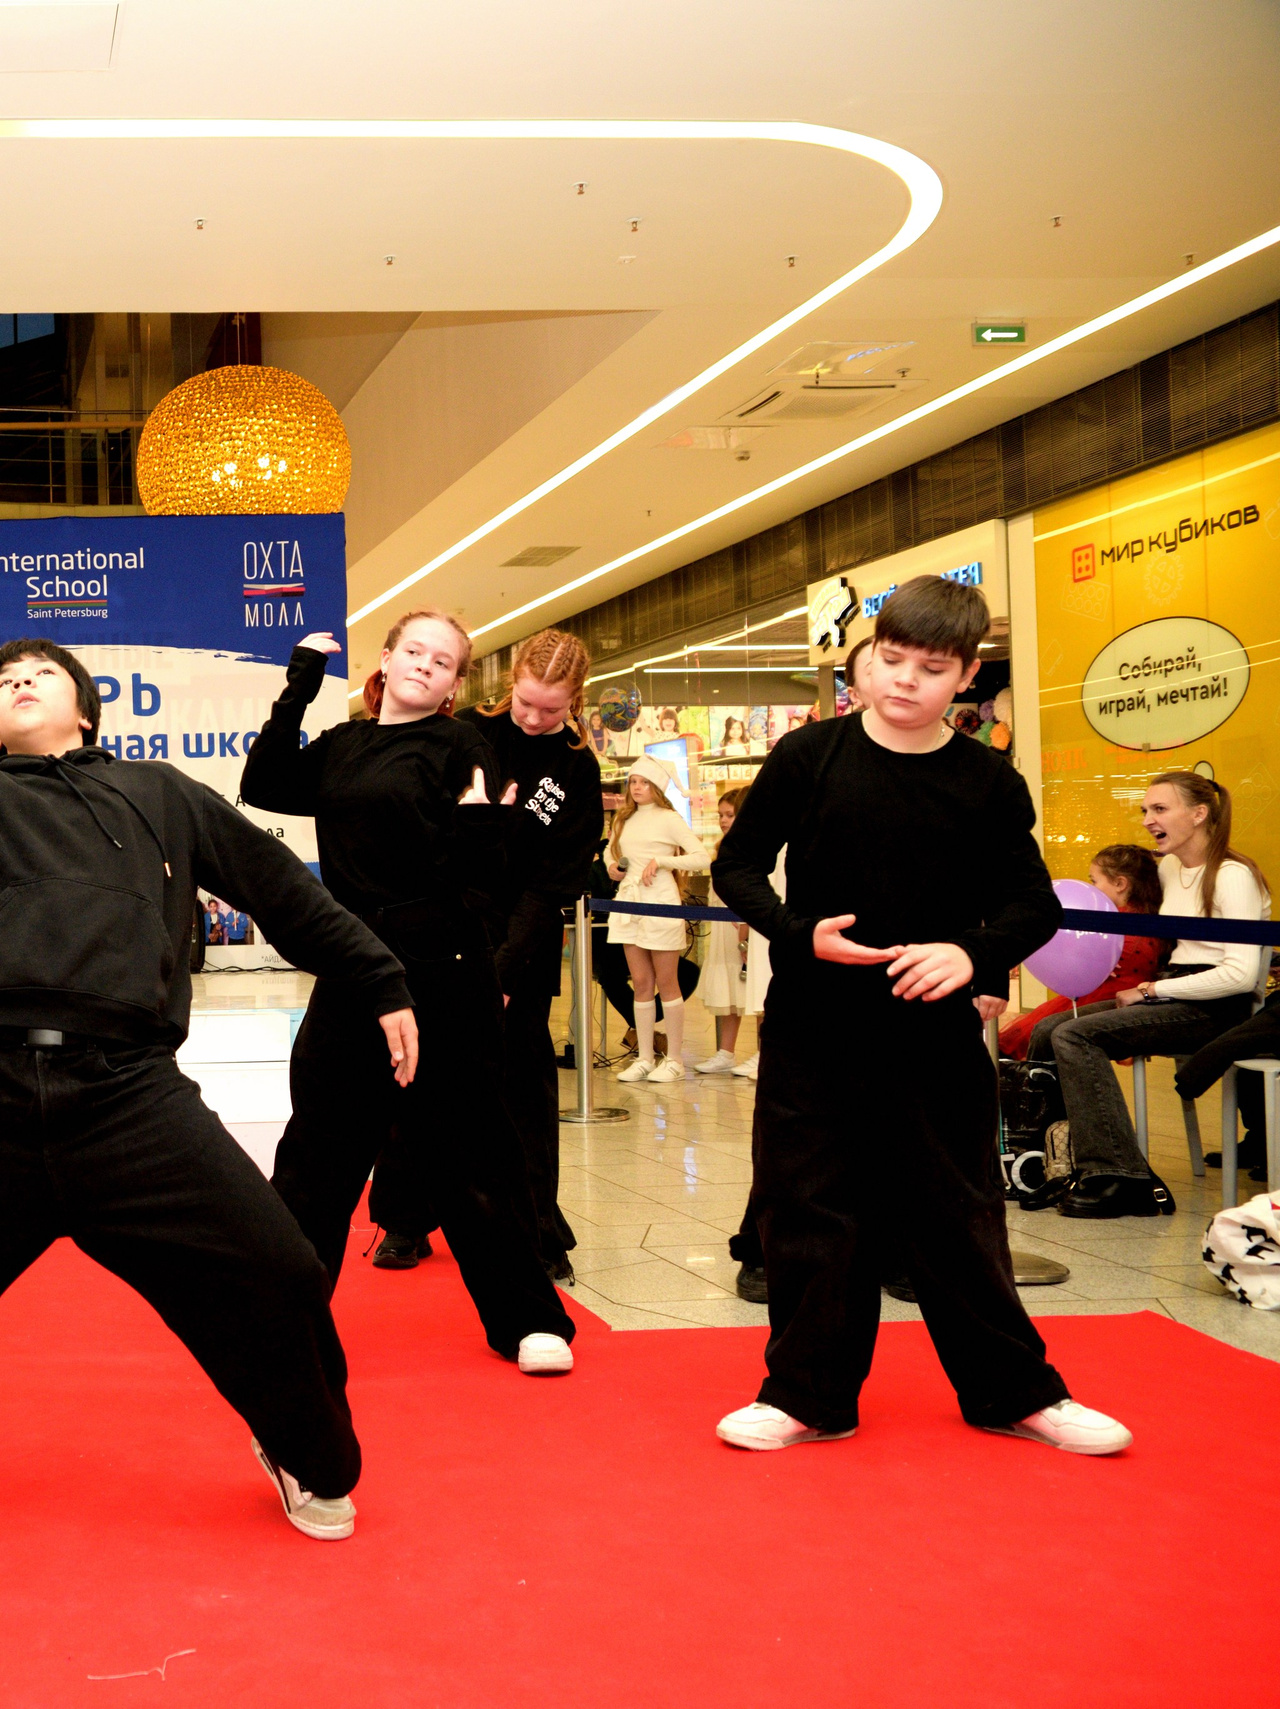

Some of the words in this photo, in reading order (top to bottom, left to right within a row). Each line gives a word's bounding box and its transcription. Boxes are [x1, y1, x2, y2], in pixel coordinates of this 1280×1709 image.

[1101, 538, 1144, 564] мир
[1148, 504, 1260, 554] кубиков
[243, 540, 304, 580] ОХТА
[26, 574, 108, 598] School
[26, 608, 53, 619] Saint
[54, 607, 109, 619] Petersburg
[244, 601, 304, 628] МОЛЛ
[1118, 646, 1202, 681] Собирай,
[1098, 688, 1151, 717] играй,
[1156, 675, 1229, 707] мечтай!
